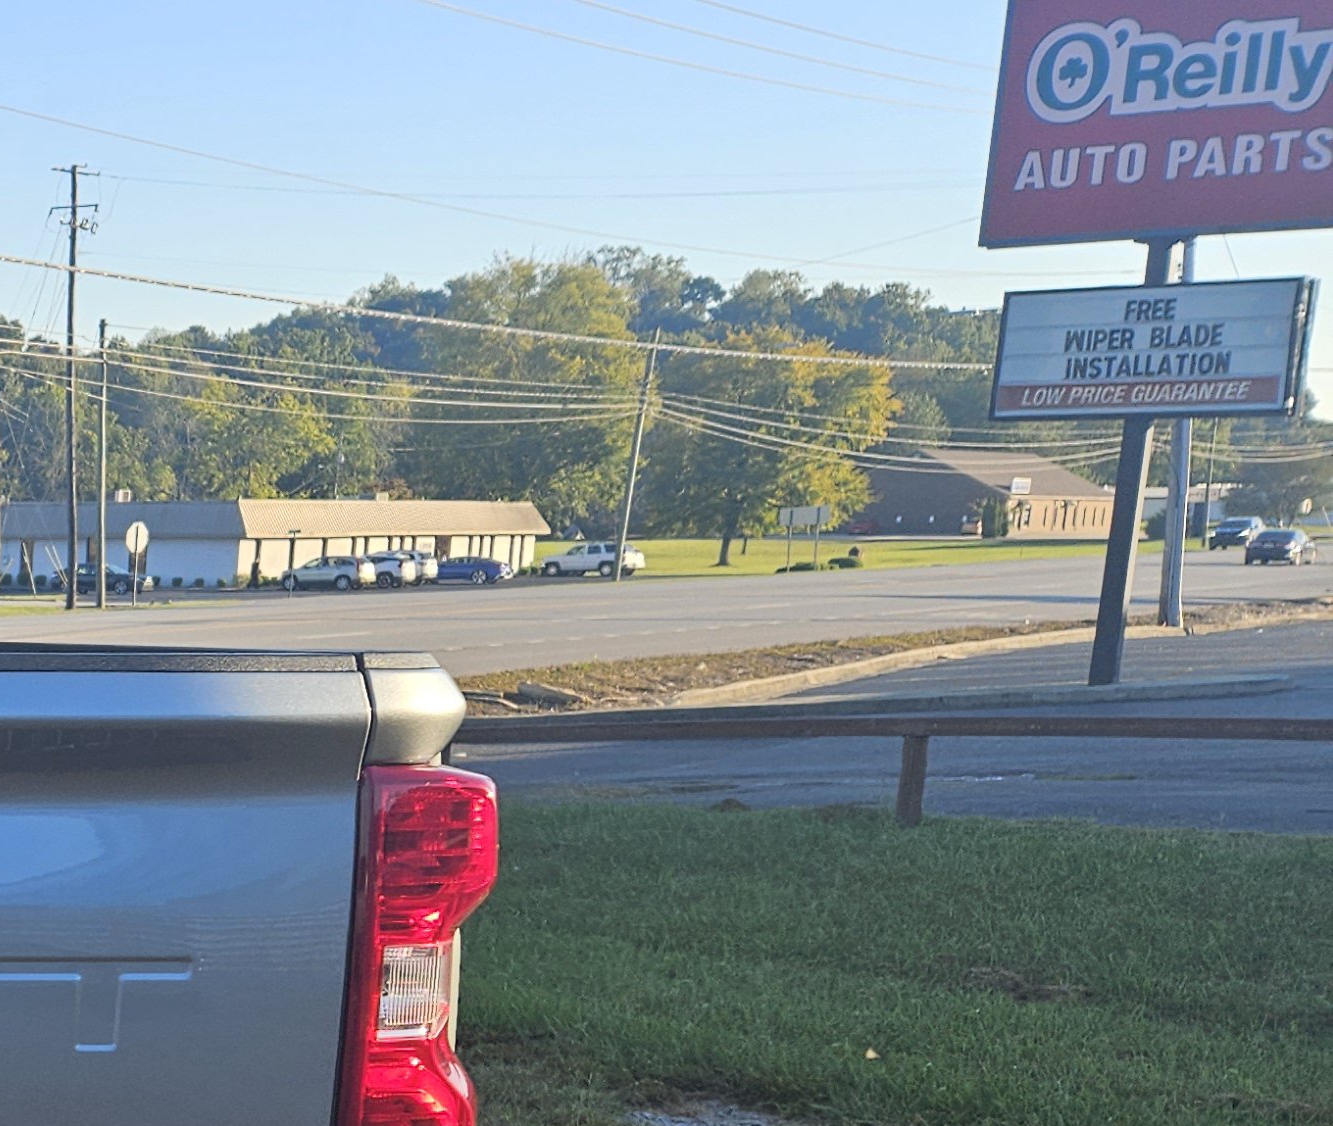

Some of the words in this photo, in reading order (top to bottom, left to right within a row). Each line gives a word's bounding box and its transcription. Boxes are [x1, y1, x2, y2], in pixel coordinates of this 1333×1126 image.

[1036, 28, 1332, 111] O'Reilly
[1014, 143, 1147, 191] AUTO
[1166, 126, 1333, 181] PARTS
[1124, 297, 1177, 322] FREE
[1064, 327, 1135, 352] WIPER
[1149, 322, 1225, 348] BLADE
[1065, 350, 1231, 380] INSTALLATION
[1021, 385, 1065, 407] LOW
[1067, 382, 1125, 405] PRICE
[1131, 379, 1251, 403] GUARANTEE
